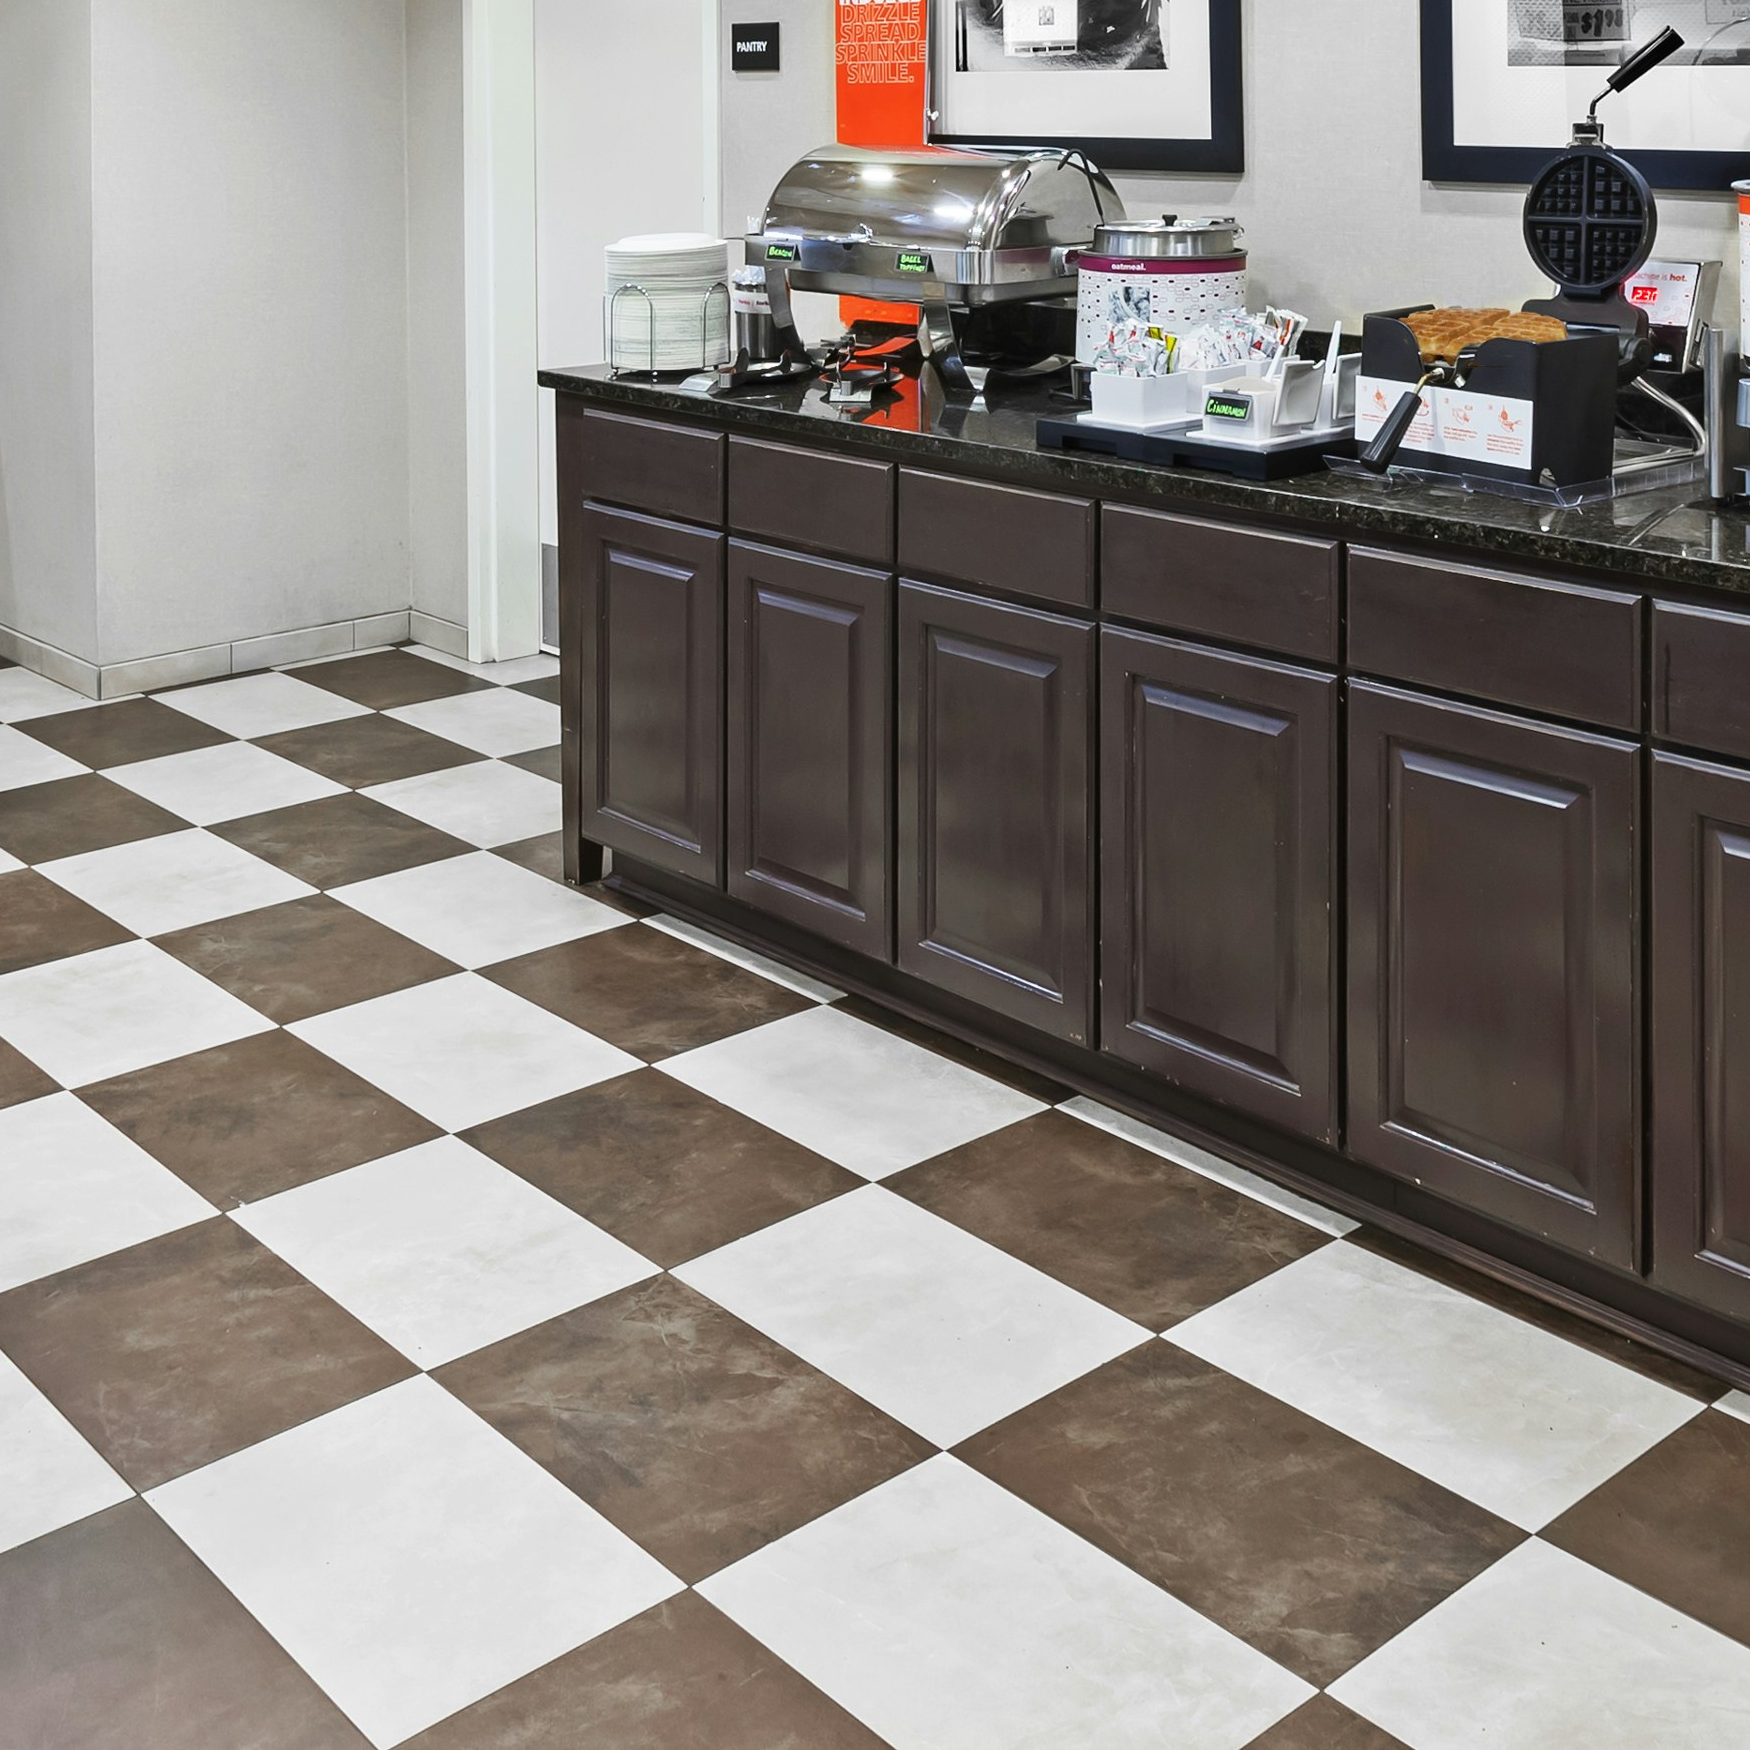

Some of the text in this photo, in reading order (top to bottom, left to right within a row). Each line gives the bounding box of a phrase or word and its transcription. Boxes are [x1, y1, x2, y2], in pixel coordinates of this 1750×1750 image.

[842, 2, 920, 24] DRIZZLE
[840, 21, 921, 44] SPREAD
[736, 40, 768, 53] PANTRY
[835, 40, 926, 64] SPRINKLE
[846, 62, 915, 84] SMILE.
[1111, 262, 1147, 271] oatmeal.
[1669, 272, 1688, 282] hot.
